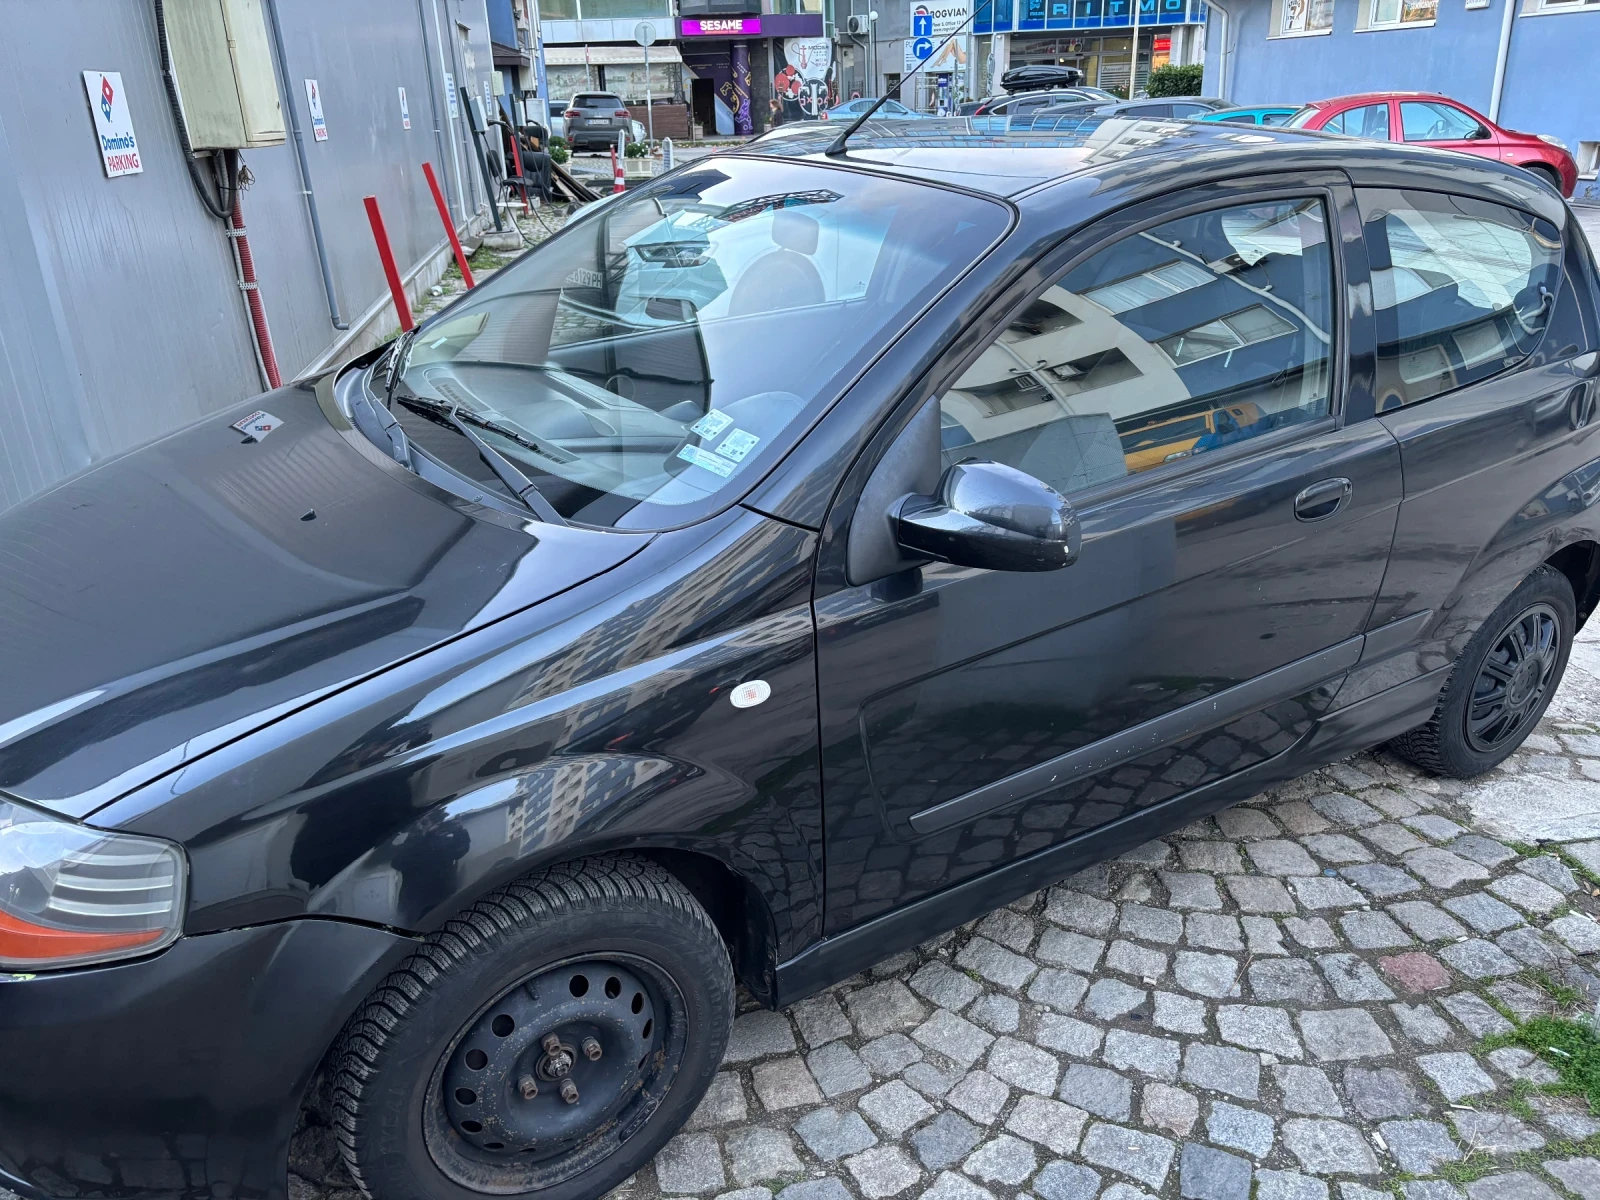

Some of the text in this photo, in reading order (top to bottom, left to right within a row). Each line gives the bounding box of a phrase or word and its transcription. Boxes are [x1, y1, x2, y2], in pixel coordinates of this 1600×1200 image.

[1052, 0, 1181, 15] RITMO
[700, 20, 743, 30] SESAME
[101, 132, 135, 151] Domino's
[107, 153, 139, 172] PARKING
